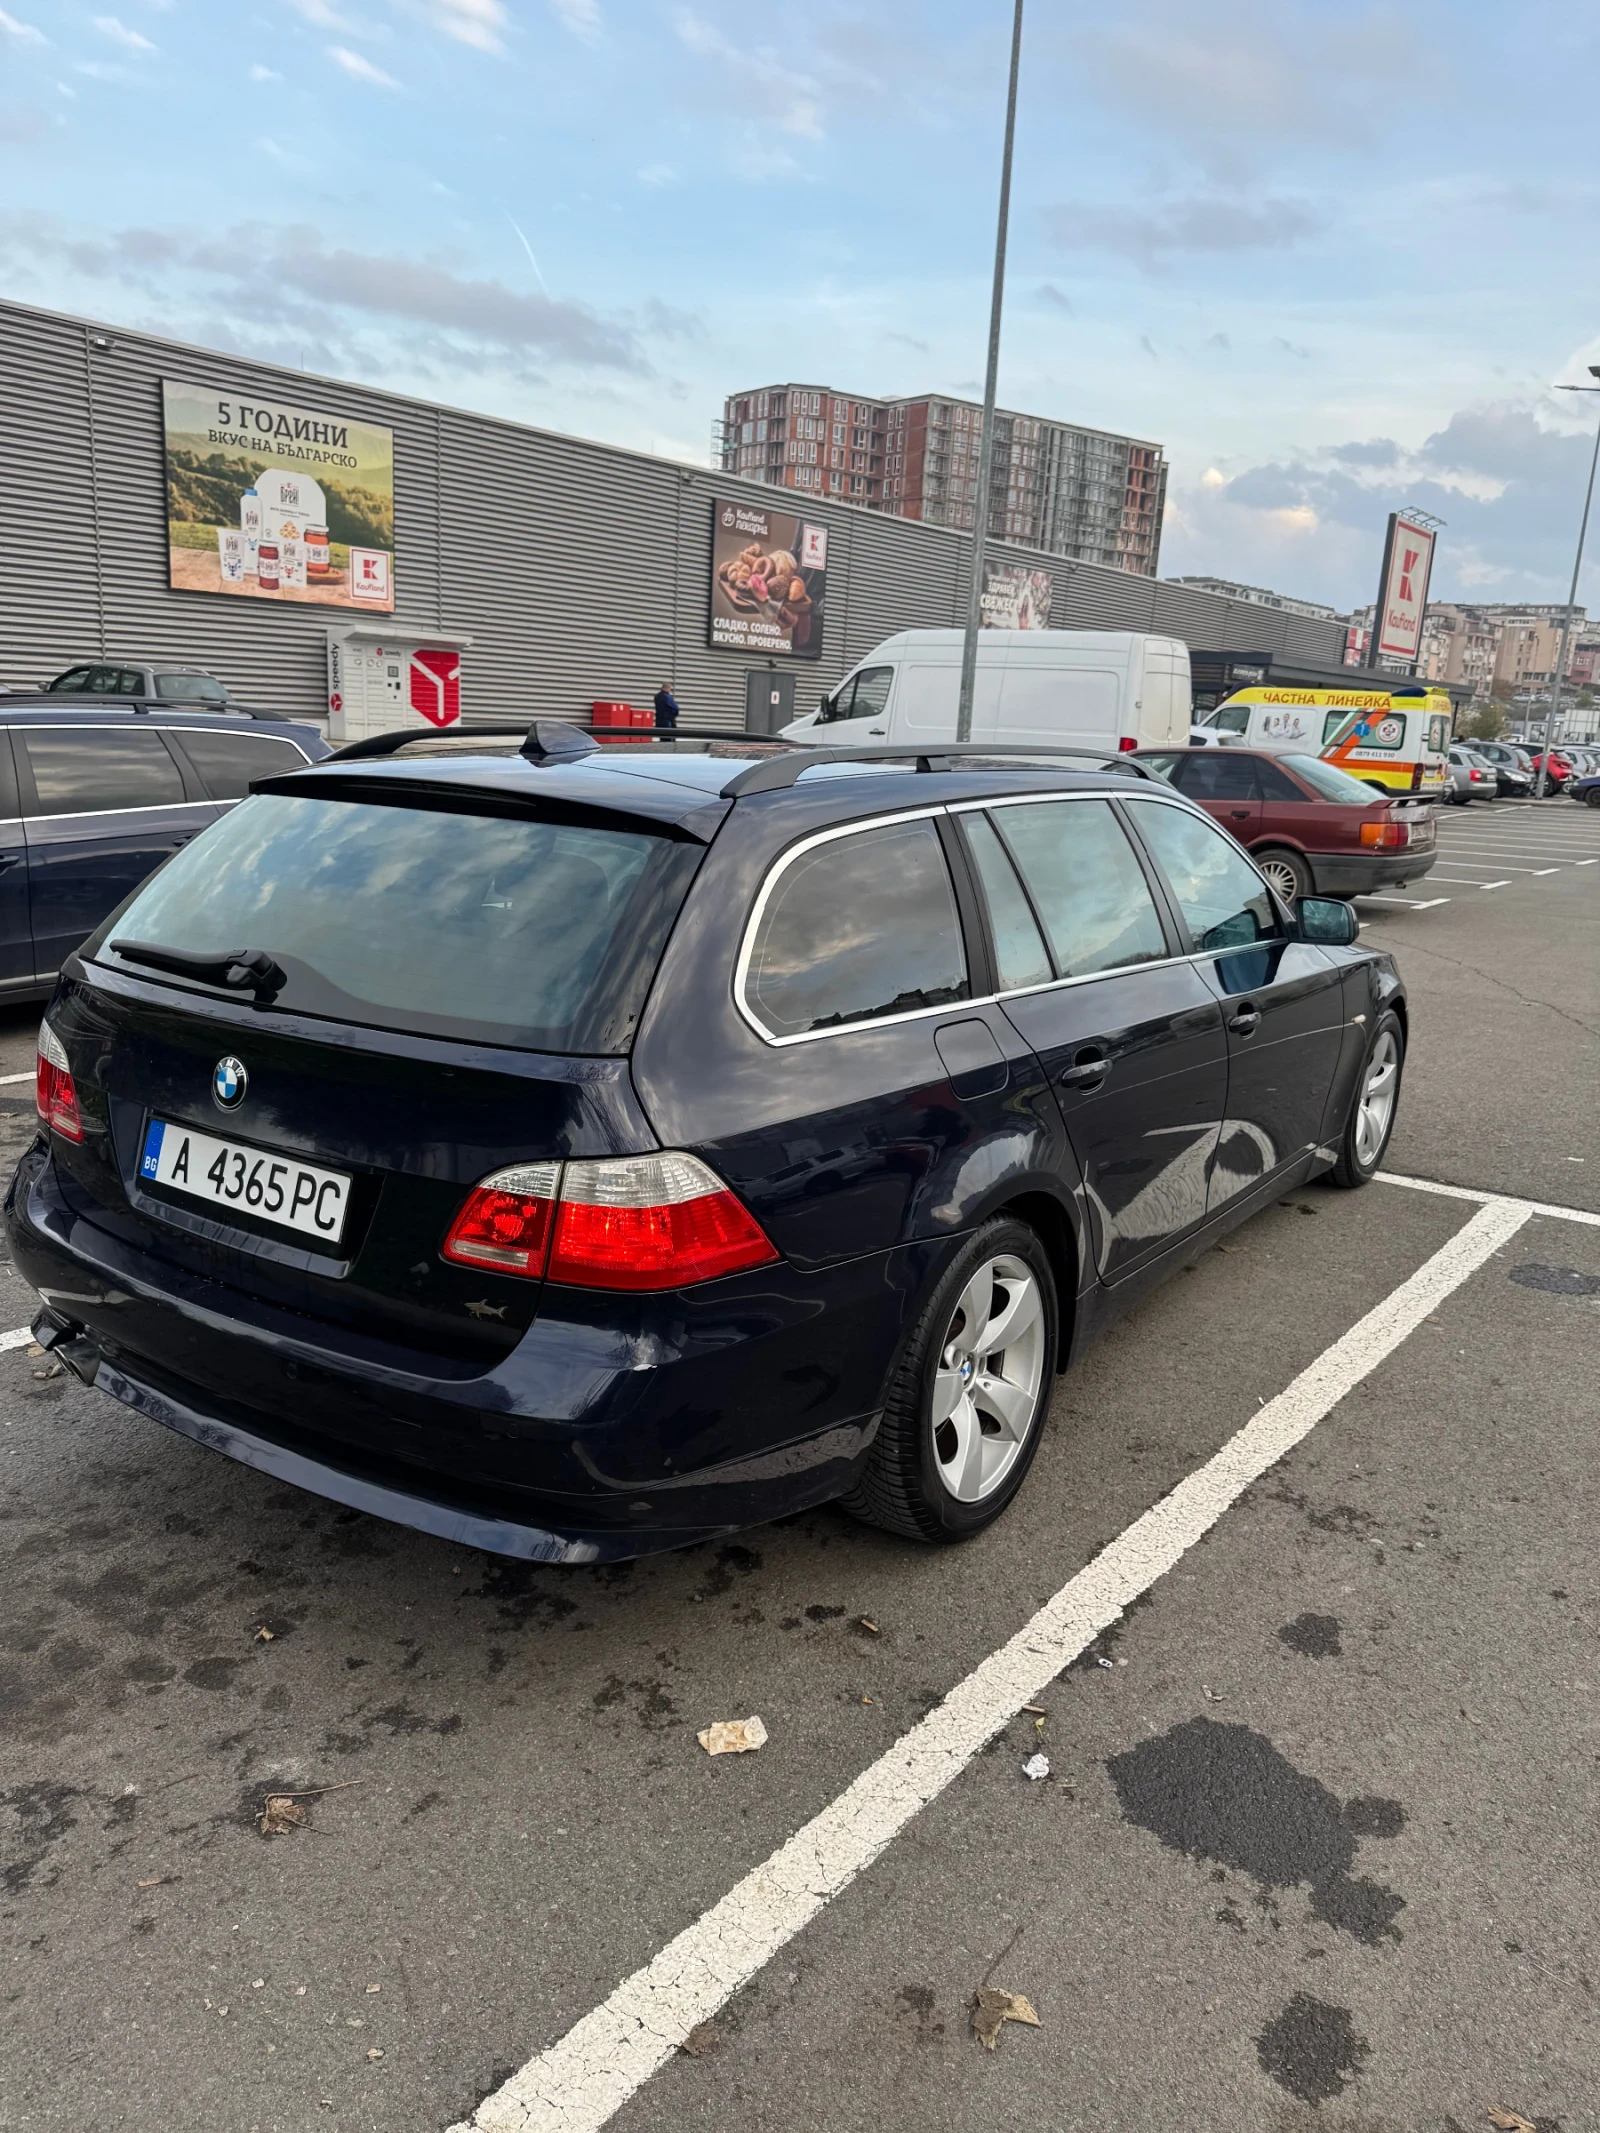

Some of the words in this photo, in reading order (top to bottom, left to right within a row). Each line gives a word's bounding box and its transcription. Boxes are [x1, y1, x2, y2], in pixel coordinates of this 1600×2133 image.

[218, 401, 231, 425] 5
[239, 405, 348, 448] ГОДИНИ
[208, 429, 248, 448] ВКУС
[251, 437, 273, 453] НА
[276, 441, 358, 469] БЪЛГАРСКО
[737, 509, 765, 524] Kaufland
[356, 582, 385, 592] Kaufland
[713, 617, 749, 632] СЛАДКО.
[750, 622, 782, 636] СОЛЕНО.
[1387, 609, 1417, 632] Kaufland
[713, 631, 746, 645] ВКУСНО.
[747, 636, 793, 650] ПРОВЕРЕНО.
[331, 643, 340, 690] speedy
[1263, 692, 1315, 705] ЧАСТНА
[1325, 694, 1391, 708] ЛИНЕЙКА
[144, 1156, 157, 1171] BG
[171, 1137, 190, 1184] A
